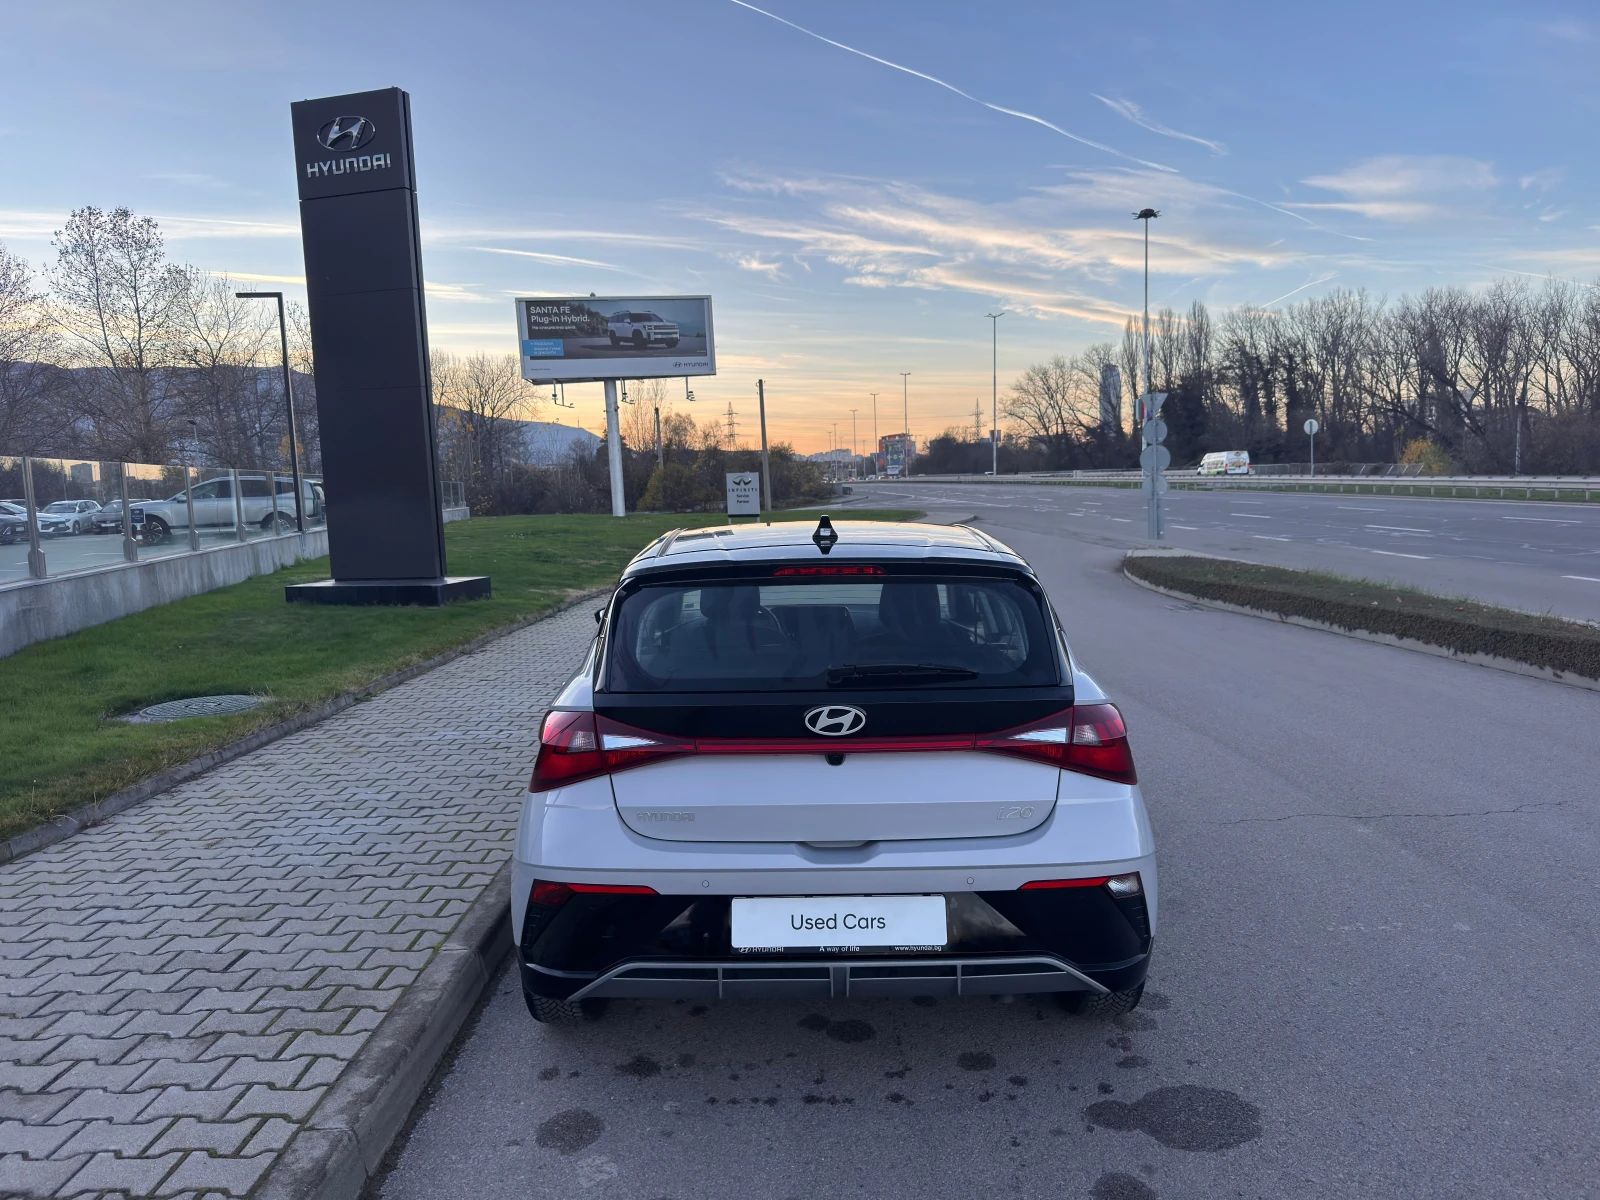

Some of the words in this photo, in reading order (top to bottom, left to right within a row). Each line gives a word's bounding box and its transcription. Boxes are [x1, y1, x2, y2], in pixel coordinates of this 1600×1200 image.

[306, 153, 391, 178] HYUNDAI
[530, 306, 559, 314] SANTA
[560, 306, 571, 314] FE
[531, 315, 560, 324] Plug-in
[561, 314, 590, 324] Hybrid.
[637, 811, 696, 821] HYUNDAI
[790, 913, 838, 930] Used
[843, 913, 886, 930] Cars
[894, 944, 942, 952] www.hyundai.bg
